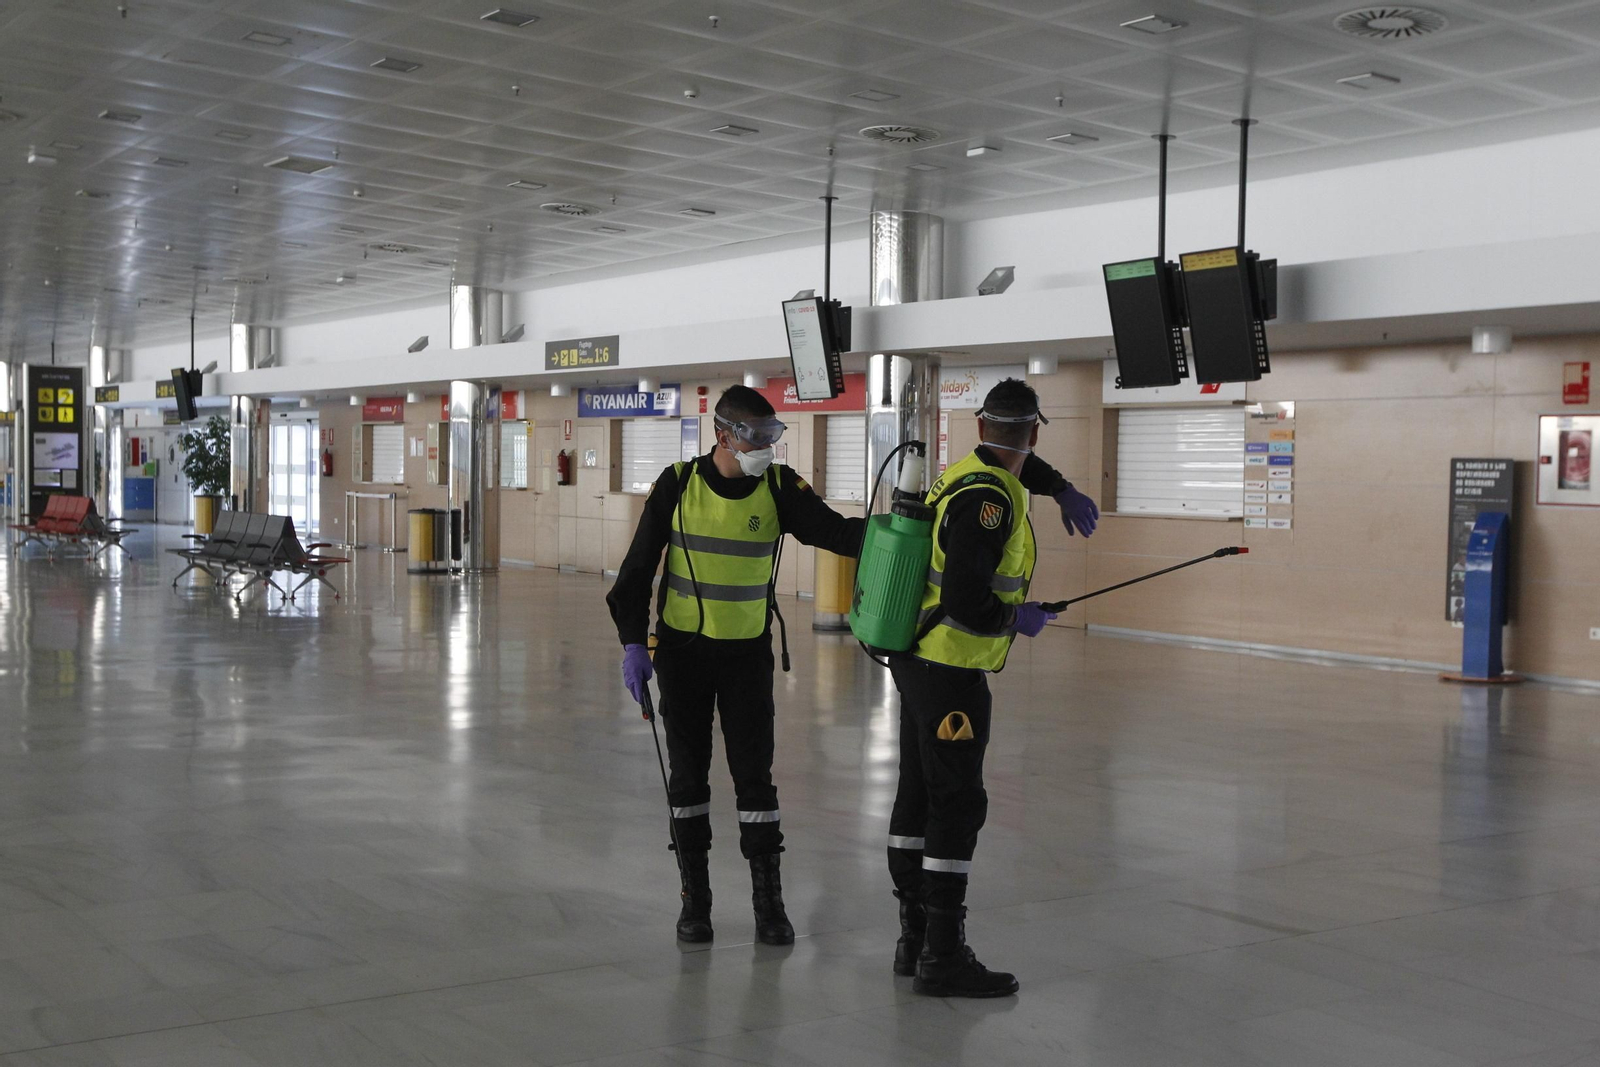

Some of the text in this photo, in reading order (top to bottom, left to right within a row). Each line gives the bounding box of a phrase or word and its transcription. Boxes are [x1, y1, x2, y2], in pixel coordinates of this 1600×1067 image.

[603, 347, 609, 363] 6
[592, 393, 647, 410] RYANAIR
[656, 392, 673, 400] AZUL
